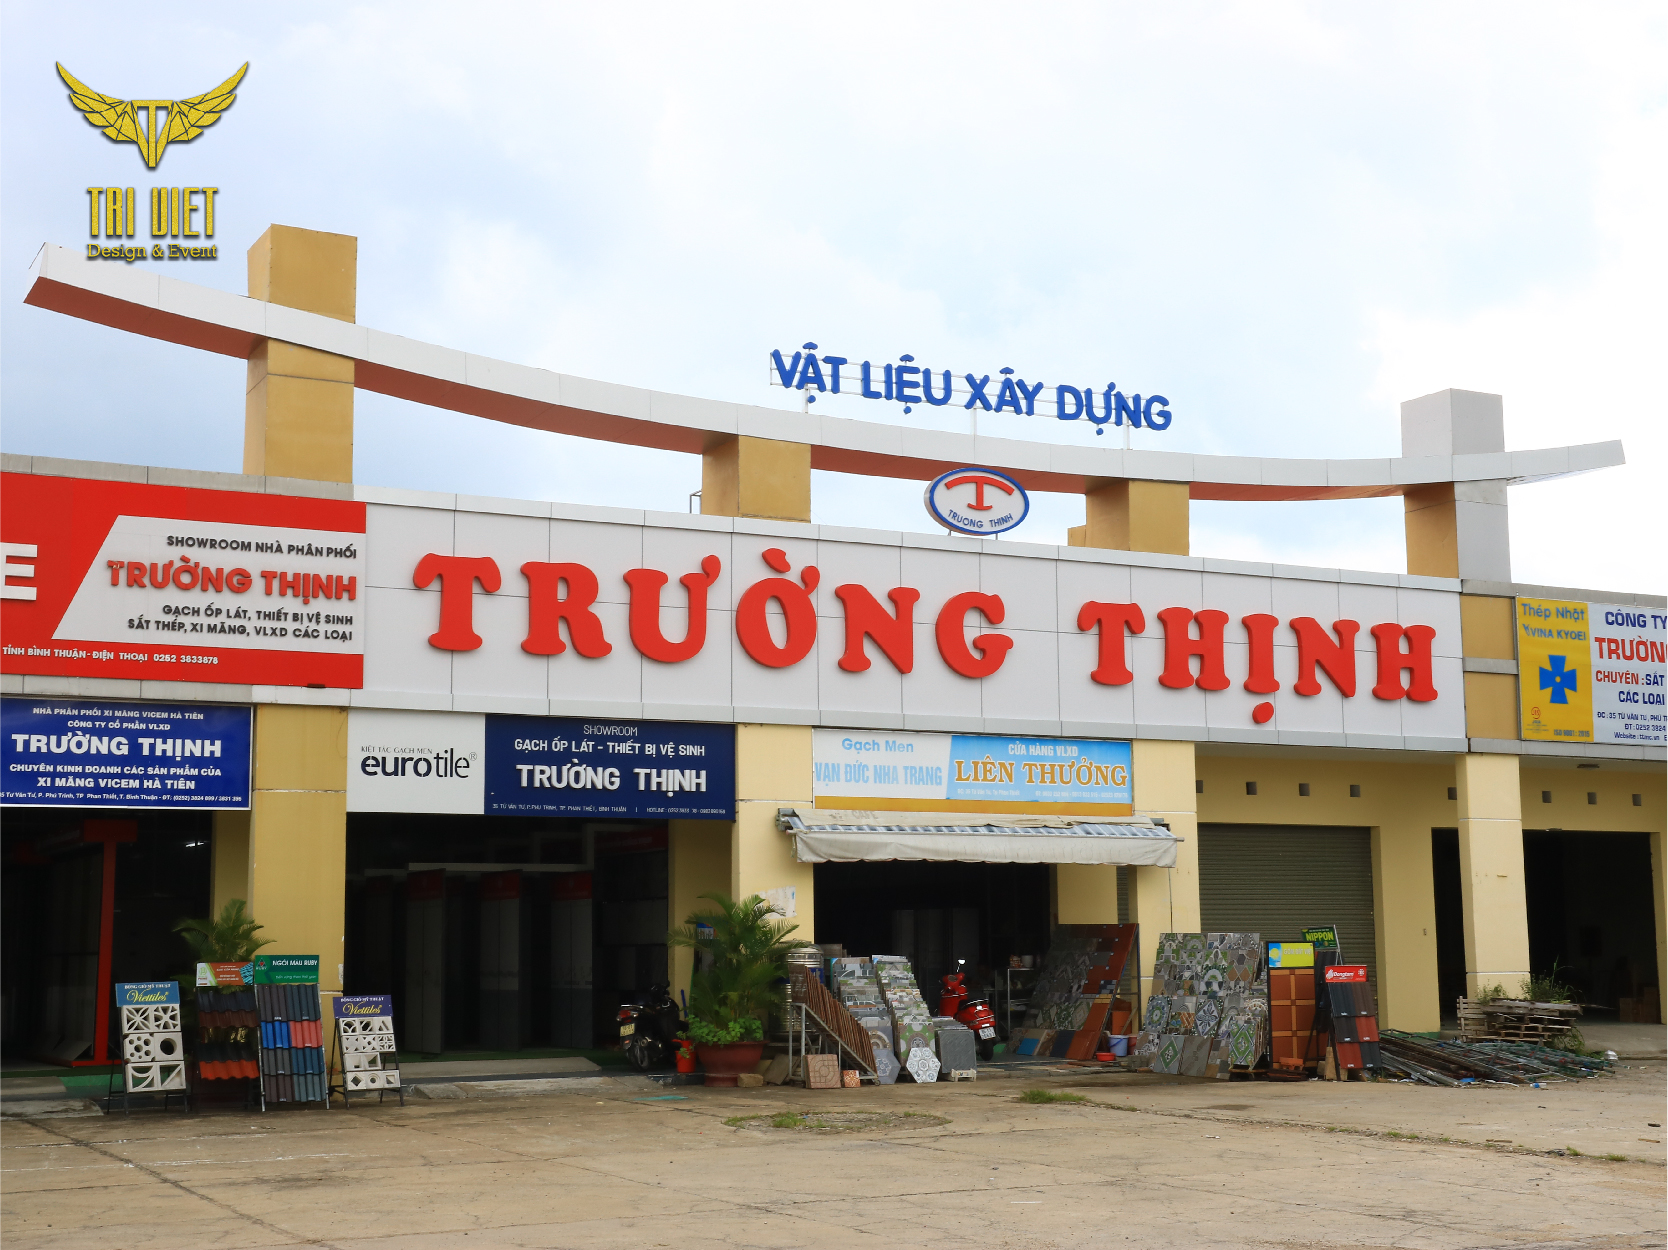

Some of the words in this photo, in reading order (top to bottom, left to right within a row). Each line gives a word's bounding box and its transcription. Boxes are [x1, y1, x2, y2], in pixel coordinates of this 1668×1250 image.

[772, 342, 847, 404] VẬT
[861, 354, 952, 414] LIỆU
[964, 366, 1043, 416] XÂY
[1056, 382, 1172, 436] DỰNG
[948, 509, 984, 528] TRUONG
[989, 513, 1014, 528] THINH
[166, 536, 252, 552] SHOWROOM
[256, 540, 284, 554] NHÀ
[288, 543, 324, 557] PHÂN
[326, 544, 356, 559] PHỐI
[107, 554, 253, 594] TRƯỜNG
[260, 570, 356, 605] THỊNH
[162, 604, 200, 618] GẠCH
[204, 602, 222, 618] ỐP
[226, 606, 252, 621] LÁT,
[256, 607, 288, 622] THIẾT
[292, 612, 304, 624] BỊ
[306, 611, 321, 626] VỆ
[324, 614, 353, 625] SINH
[1522, 604, 1552, 620] Thép
[1556, 606, 1584, 623] Nhật
[1605, 609, 1646, 628] CÔNG
[128, 614, 150, 630] SẮT
[154, 618, 187, 634] THÉP,
[190, 622, 203, 633] XI
[208, 622, 250, 636] MĂNG,
[254, 626, 288, 637] VLXD
[293, 626, 320, 638] CÁC
[325, 630, 352, 642] LOẠI
[411, 547, 1014, 680] TRƯỜNG
[1075, 599, 1440, 724] THỊNH
[1557, 629, 1586, 640] KYOEI
[2, 644, 25, 655] TỈNH
[28, 645, 51, 657] BÌNH
[119, 652, 148, 662] THOẠI
[153, 654, 176, 662] 0252
[180, 655, 218, 664] 3833878
[1594, 636, 1667, 663] TRƯỜN
[1596, 670, 1639, 685] CHUYÊN
[1619, 689, 1639, 703] CÁC
[1643, 692, 1665, 705] LOẠI
[54, 707, 78, 715] PHÂN
[80, 707, 101, 716] PHỐI
[170, 711, 182, 719] HÀ
[68, 720, 92, 728] CÔNG
[108, 719, 120, 728] CỔ
[123, 720, 146, 729] PHẦN
[583, 724, 638, 736] SHOWROOM
[12, 731, 129, 755] TRƯỜNG
[138, 738, 221, 761] THỊNH
[394, 747, 414, 755] GẠCH
[514, 738, 548, 753] GẠCH
[552, 736, 568, 752] ỐP
[572, 739, 595, 752] LÁT
[607, 740, 641, 754] THIẾT
[645, 744, 656, 757] BỊ
[660, 742, 675, 758] VỆ
[679, 745, 705, 756] SINH
[842, 738, 880, 754] Gạch
[885, 740, 914, 752] Men
[1008, 741, 1027, 756] CỬA
[1029, 743, 1054, 756] HÀNG
[1056, 745, 1078, 756] VLXD
[10, 763, 54, 772] CHUYÊN
[85, 765, 121, 774] DOANH
[124, 765, 144, 774] CÁC
[147, 765, 167, 775] SẢN
[170, 764, 198, 776] PHẨM
[201, 766, 221, 776] CỦA
[361, 748, 470, 778] eurotile
[954, 754, 1015, 784] LIÊN
[1021, 757, 1128, 787] THƯỞNG
[37, 777, 51, 786] XI
[55, 776, 94, 787] MĂNG
[98, 778, 139, 788] VICEM
[143, 777, 162, 788] HÀ
[165, 778, 195, 789] TIÊN
[516, 758, 620, 790] TRƯỜNG
[633, 768, 706, 797] THỊNH
[815, 762, 840, 786] VẠN
[844, 760, 869, 783] ĐỨC
[874, 765, 899, 784] NHA
[903, 766, 942, 786] TRANG
[1306, 932, 1334, 941] NIPPON
